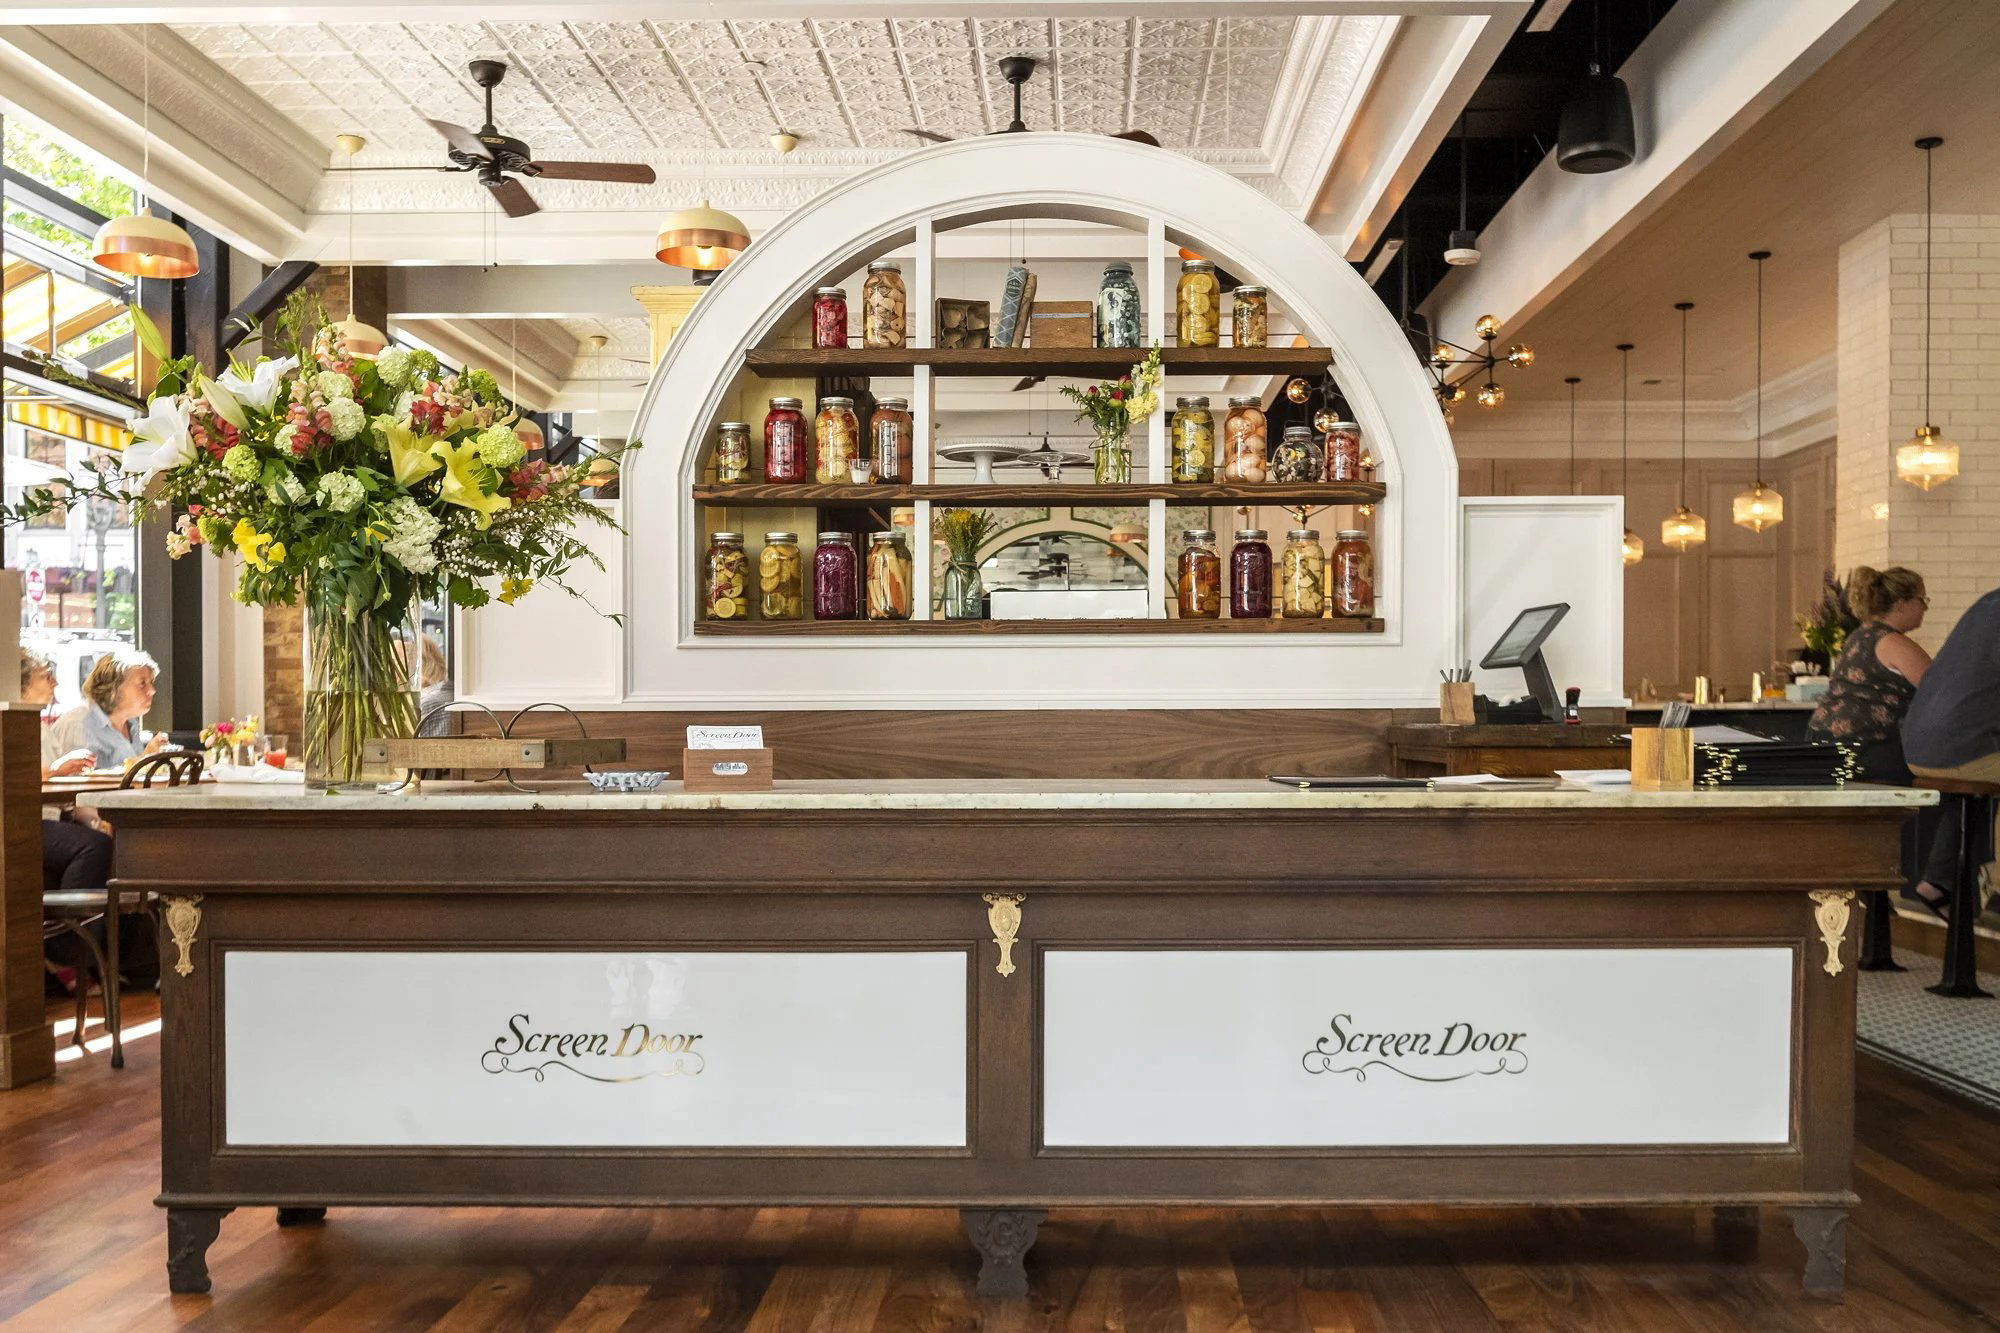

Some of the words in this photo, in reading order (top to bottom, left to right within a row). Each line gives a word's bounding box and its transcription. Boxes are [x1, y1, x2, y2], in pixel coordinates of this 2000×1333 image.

[696, 729, 731, 739] Screen
[732, 731, 758, 739] Door
[494, 1013, 609, 1058] Screen
[610, 1023, 704, 1057] Door
[1316, 1013, 1432, 1058] Screen
[1433, 1022, 1527, 1057] Door
